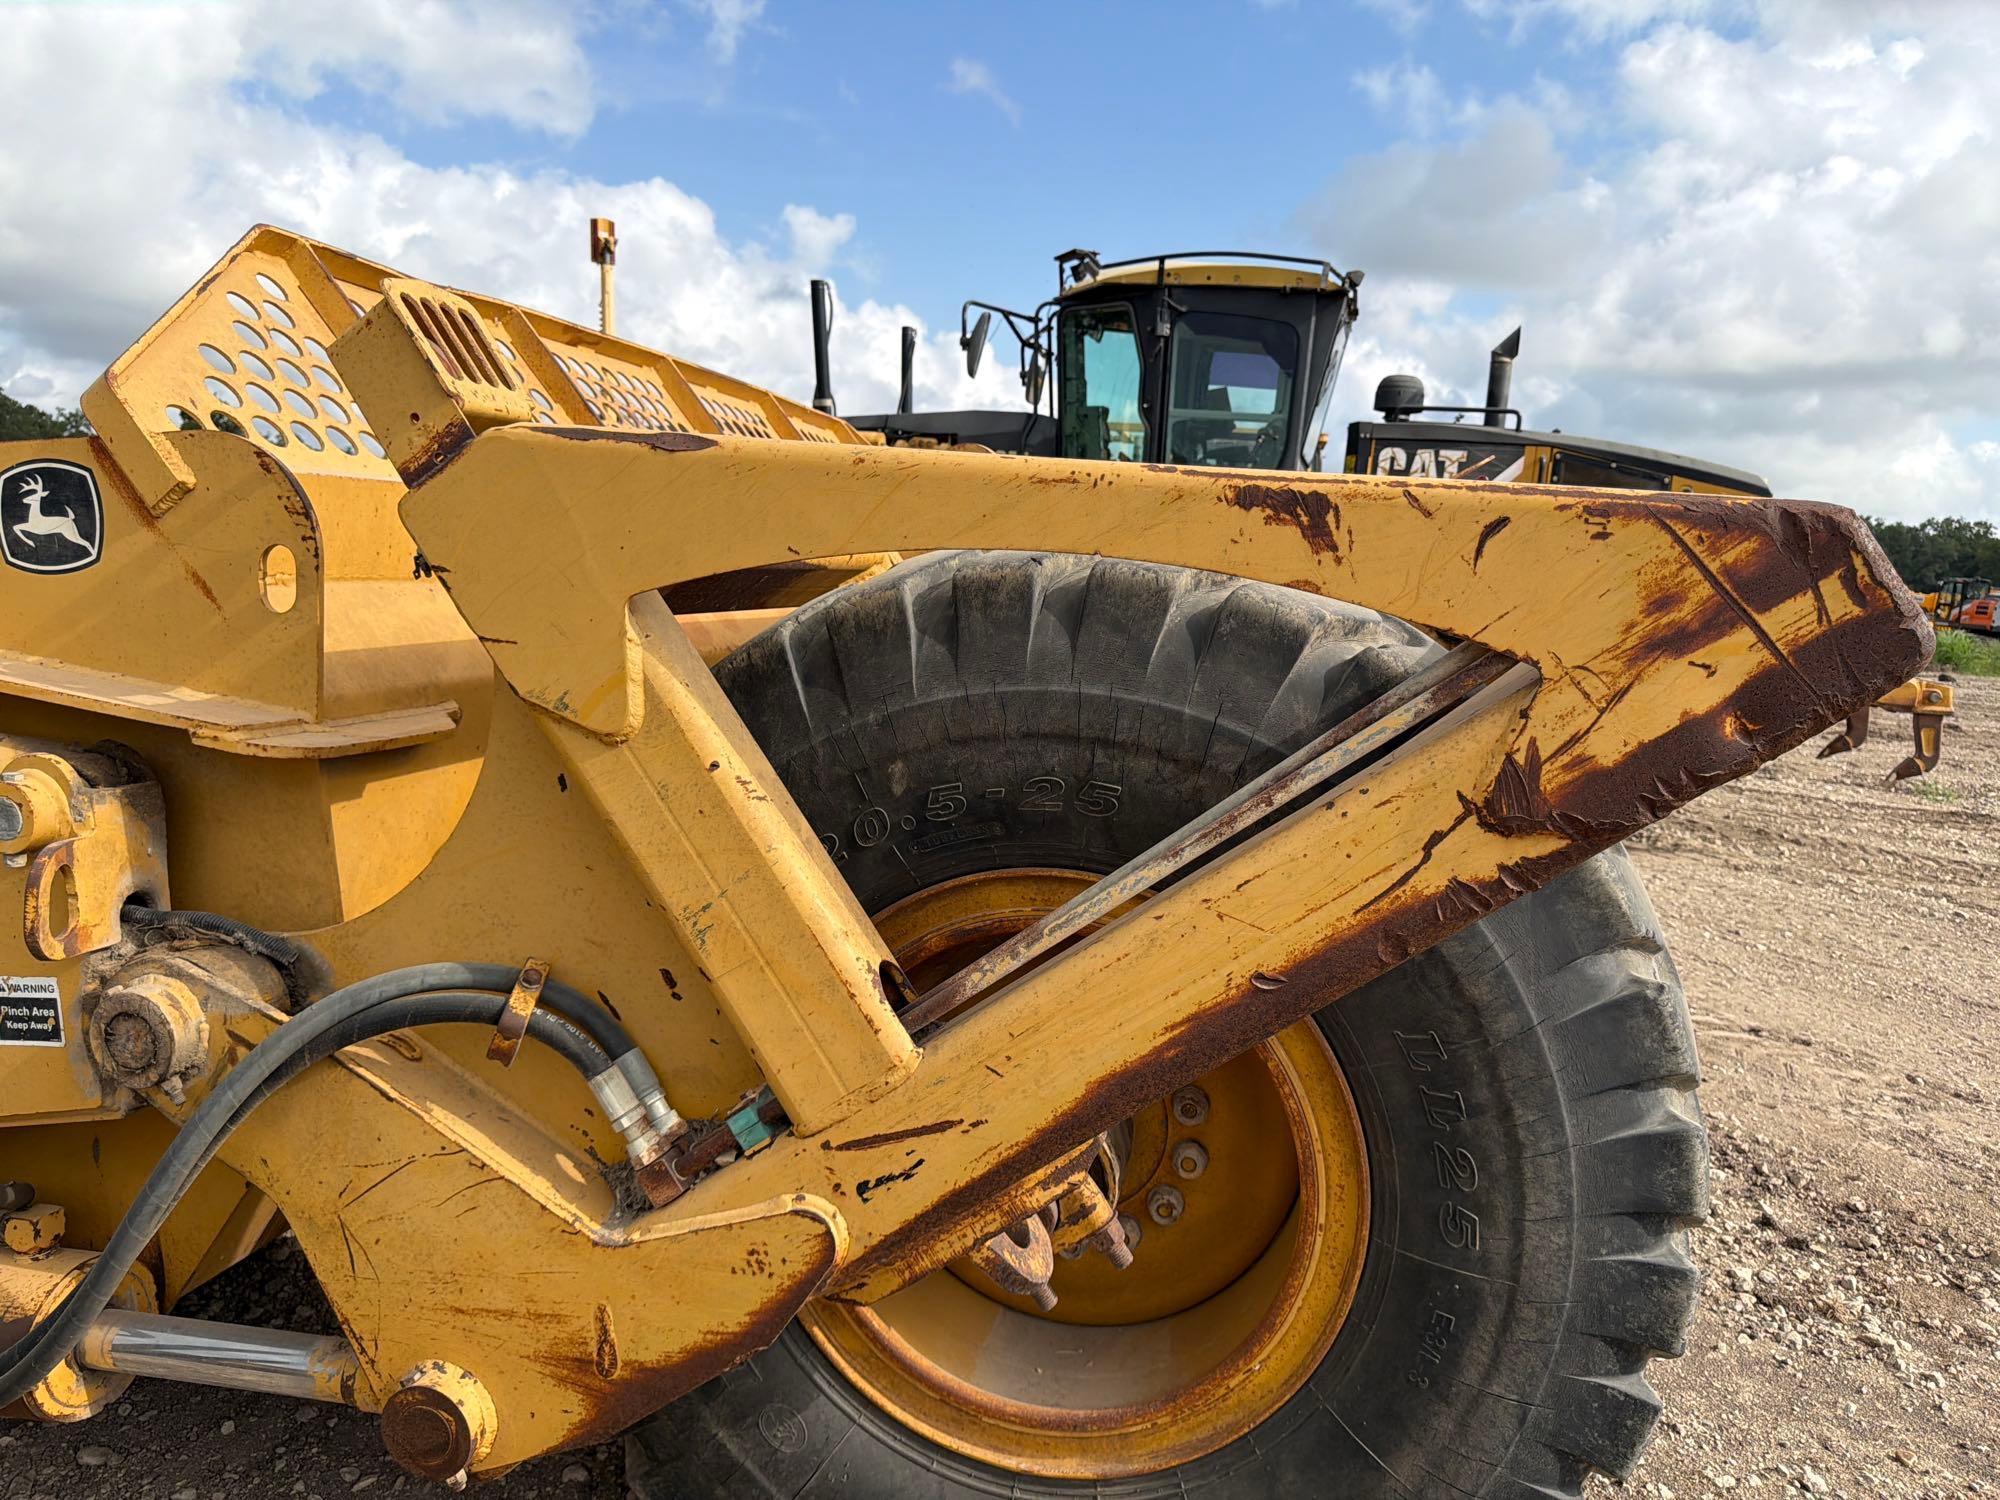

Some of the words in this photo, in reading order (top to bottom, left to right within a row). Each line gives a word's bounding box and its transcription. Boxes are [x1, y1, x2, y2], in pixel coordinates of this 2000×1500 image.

[1376, 447, 1468, 479] CAT
[7, 983, 55, 994] WARNING
[1, 1005, 30, 1017] Pinch
[32, 1006, 55, 1017] Area
[6, 1021, 29, 1031] Keep
[30, 1021, 53, 1032] Away
[1393, 1030, 1480, 1251] LL25
